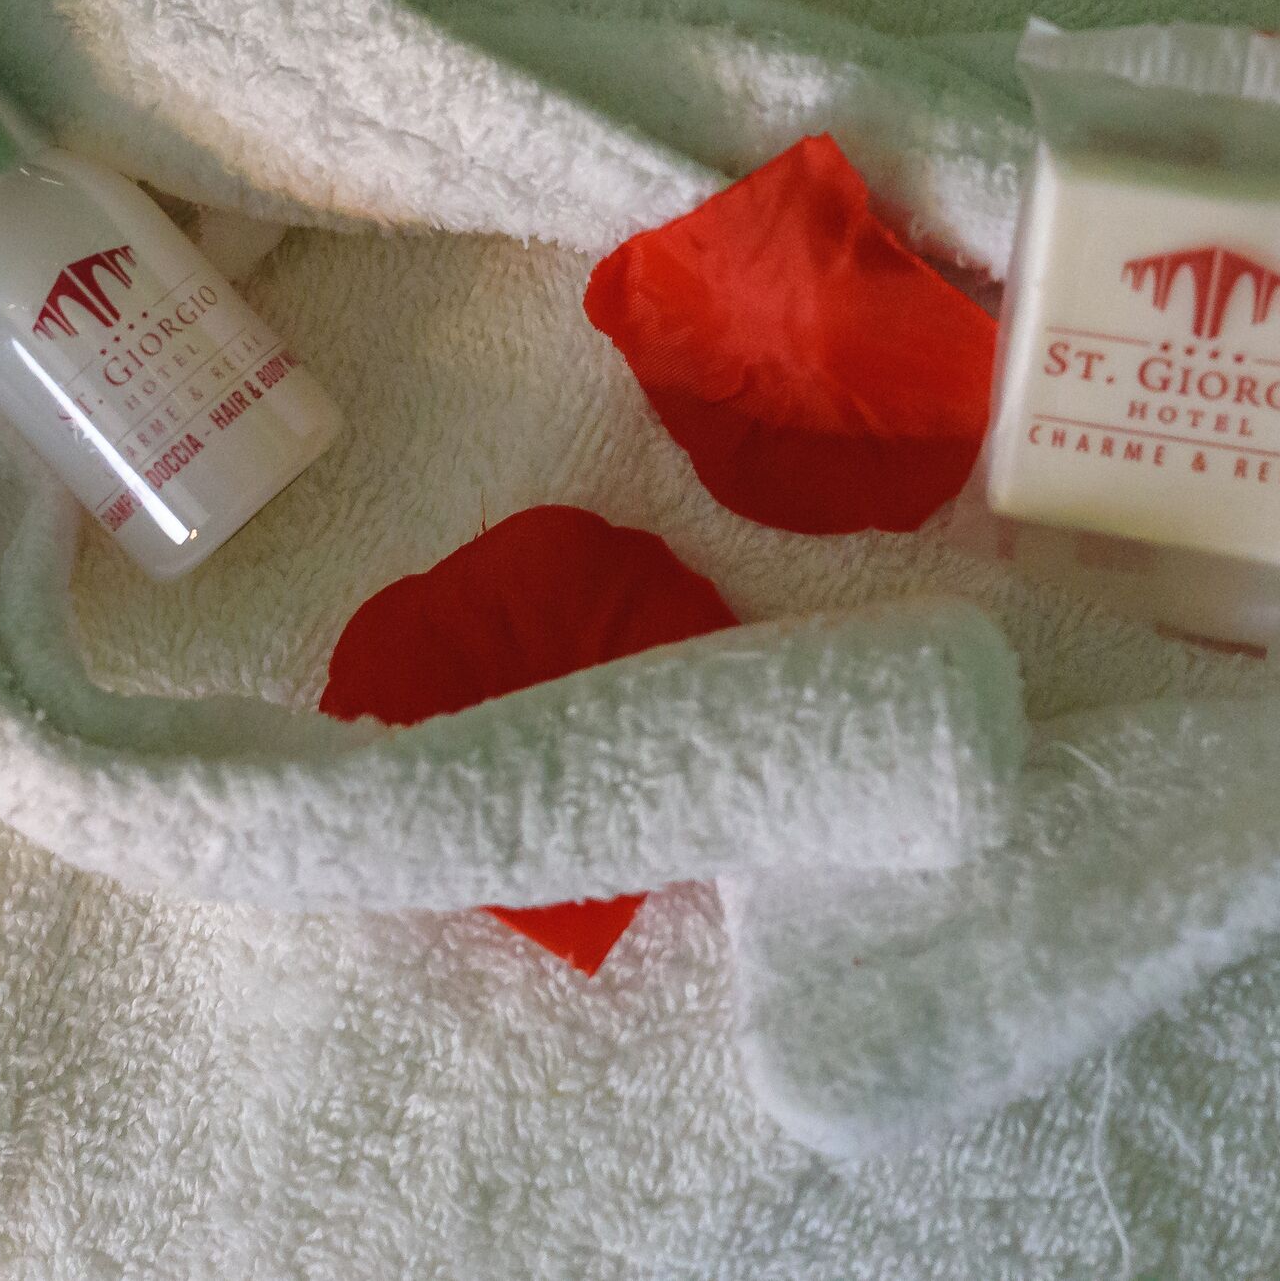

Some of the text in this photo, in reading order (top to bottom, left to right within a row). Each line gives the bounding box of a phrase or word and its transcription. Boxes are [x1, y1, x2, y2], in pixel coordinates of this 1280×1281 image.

[104, 285, 218, 387] GIORGIO
[1043, 340, 1117, 385] ST.
[124, 343, 200, 411] HOTEL
[144, 432, 205, 491] DOCCIA
[208, 389, 252, 431] HAIR
[243, 379, 264, 400] &
[1127, 400, 1254, 438] HOTEL
[1028, 424, 1166, 467] CHARME
[1191, 451, 1208, 473] &
